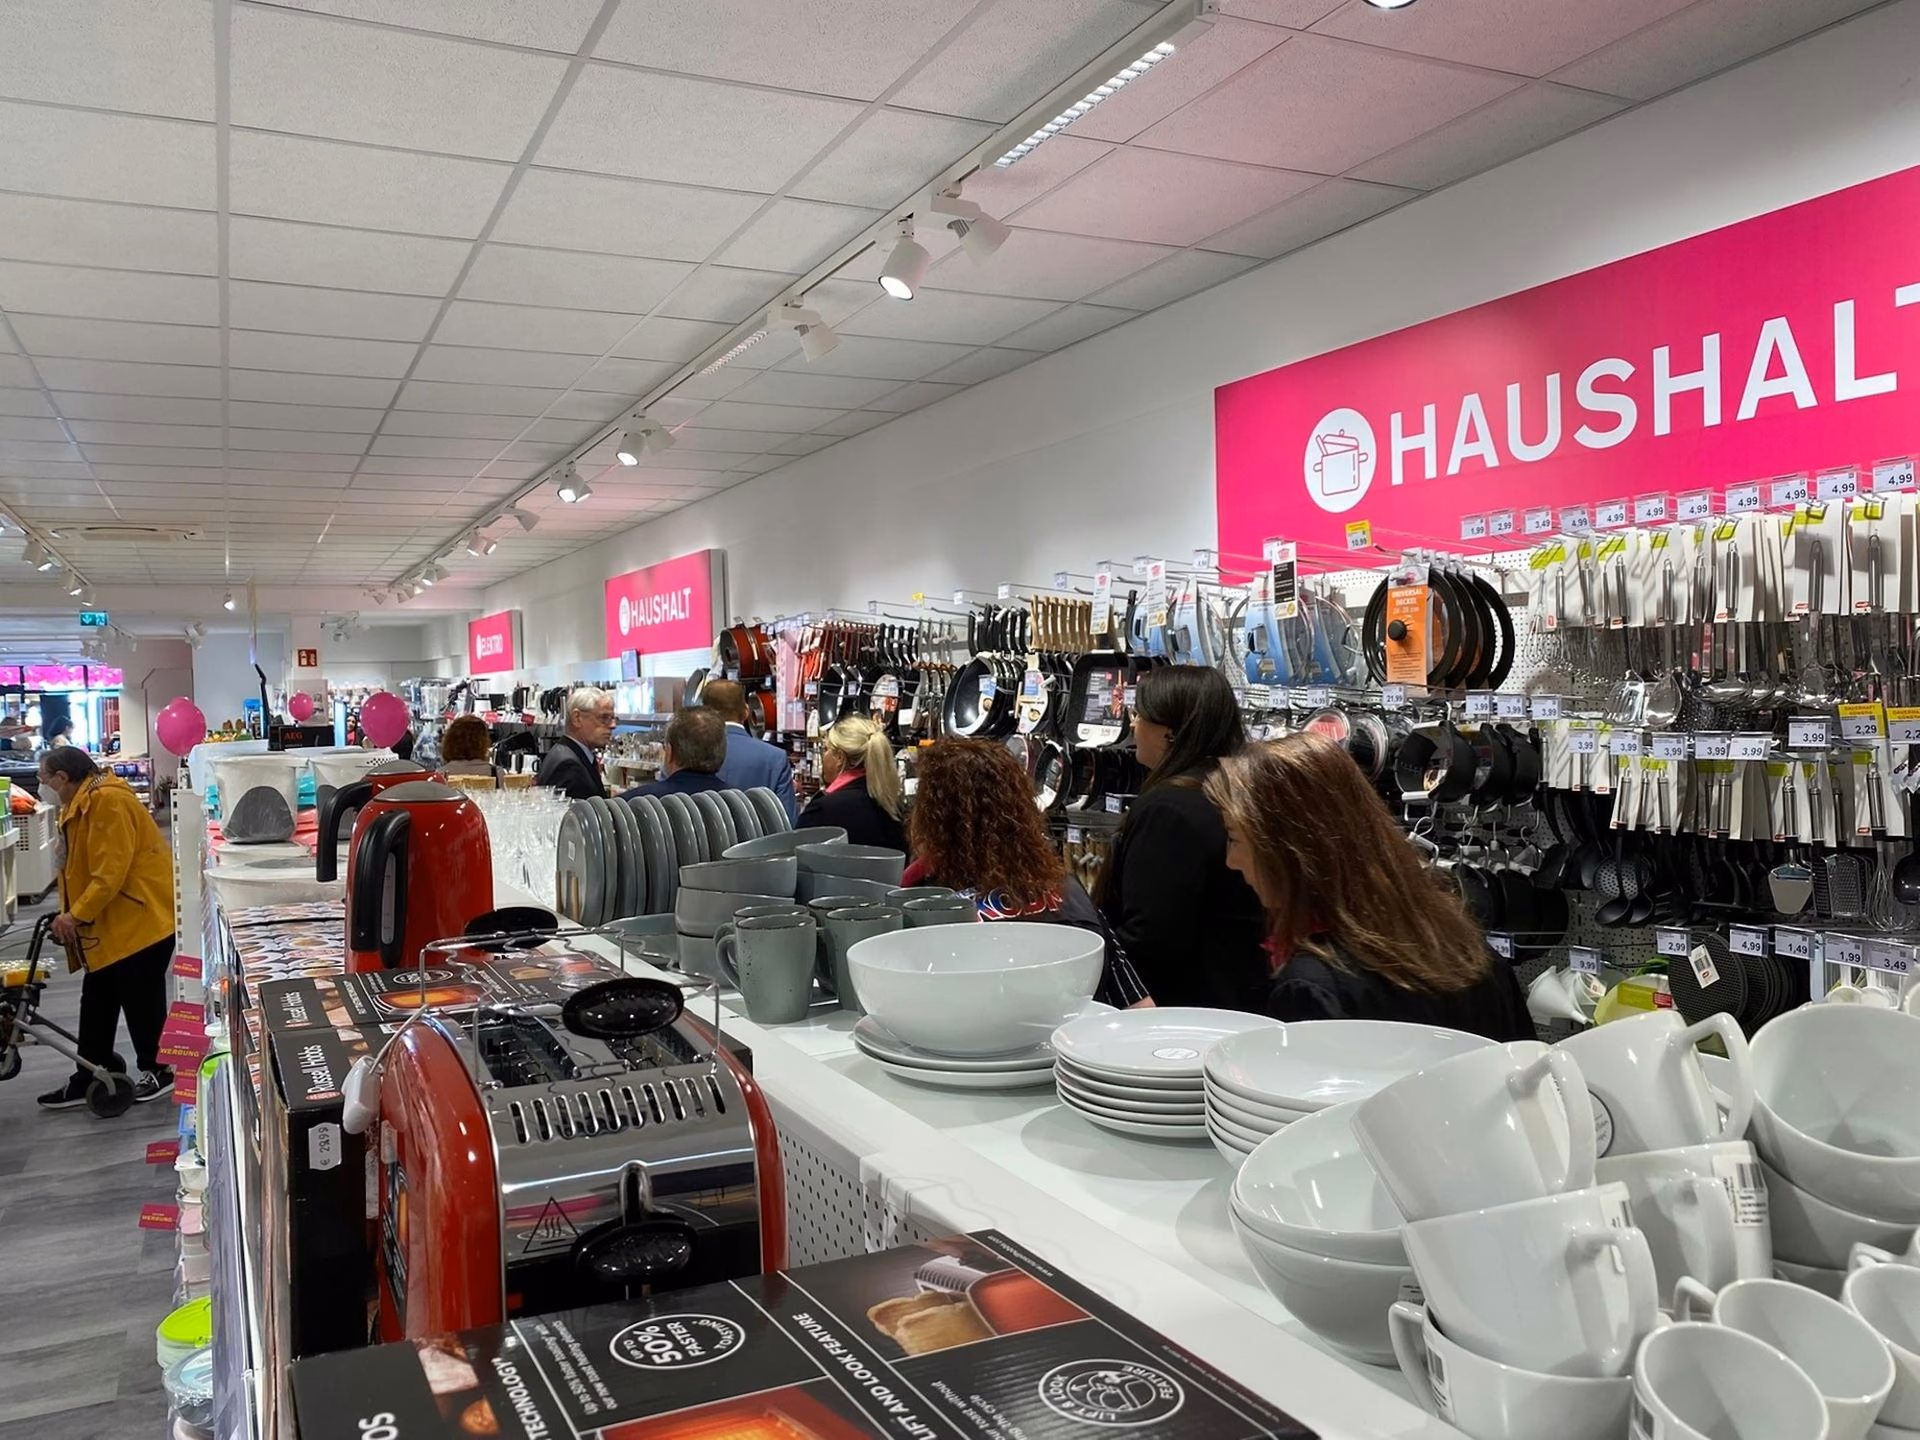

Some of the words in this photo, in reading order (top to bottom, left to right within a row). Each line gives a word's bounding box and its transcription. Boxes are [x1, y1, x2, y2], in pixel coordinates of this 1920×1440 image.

[1390, 284, 1920, 486] HAUSHAL
[1888, 473, 1913, 487] 4,99
[1831, 482, 1855, 495] 4,99
[1785, 489, 1807, 501] 4,99
[1737, 496, 1758, 508] 4,99
[1645, 506, 1664, 518] 4,99
[1689, 504, 1708, 516] 4,99
[1571, 517, 1588, 528] 4,99
[1606, 512, 1624, 523] 4,99
[1470, 525, 1485, 535] 1,99
[1498, 521, 1512, 532] 2,99
[1535, 519, 1551, 530] 3,49
[630, 586, 692, 629] HAUSHALT
[1474, 703, 1488, 711] 3,99
[1507, 705, 1522, 714] 3,99
[1541, 708, 1557, 717] 3,99
[285, 731, 303, 740] AEG
[1855, 725, 1877, 735] 2,29
[1802, 733, 1824, 743] 3,99
[1578, 741, 1594, 751] 3,99
[1620, 743, 1637, 752] 3,99
[1664, 747, 1682, 757] 3,99
[1706, 746, 1726, 756] 3,99
[1741, 747, 1763, 757] 3,99
[1668, 942, 1686, 951] 2,99
[1741, 941, 1761, 951] 4,99
[1788, 943, 1808, 954] 1,49
[1839, 951, 1861, 963] 1,99
[1580, 960, 1596, 970] 9,99
[1884, 958, 1907, 970] 3,49
[281, 991, 304, 1007] Hobbs
[170, 1012, 200, 1020] WERBUNG
[283, 1006, 309, 1024] Russell
[160, 1048, 200, 1058] WERBUNG
[297, 1044, 327, 1067] Hobbs
[302, 1066, 335, 1094] Russell
[320, 1158, 330, 1166] €
[142, 1215, 173, 1223] WERBUNG
[666, 1321, 707, 1357] FASTER
[792, 1312, 847, 1356] FEATURE
[623, 1339, 636, 1350] TO
[633, 1325, 684, 1364] 50%
[568, 1342, 590, 1367] heating
[630, 1349, 644, 1360] UP
[560, 1360, 578, 1381] faster
[581, 1364, 601, 1383] toast
[837, 1354, 879, 1387] LOOK
[1050, 1374, 1069, 1401] LOOK
[1122, 1364, 1174, 1400] FEATURE
[593, 1381, 610, 1397] new
[930, 1380, 967, 1409] without
[579, 1393, 592, 1404] to
[602, 1396, 618, 1410] our
[870, 1386, 909, 1414] AND
[970, 1394, 996, 1414] cycle
[584, 1402, 599, 1415] Up
[1073, 1407, 1116, 1421] LIFT
[962, 1408, 989, 1430] toast
[992, 1412, 1012, 1428] the
[898, 1415, 938, 1440] LIFT
